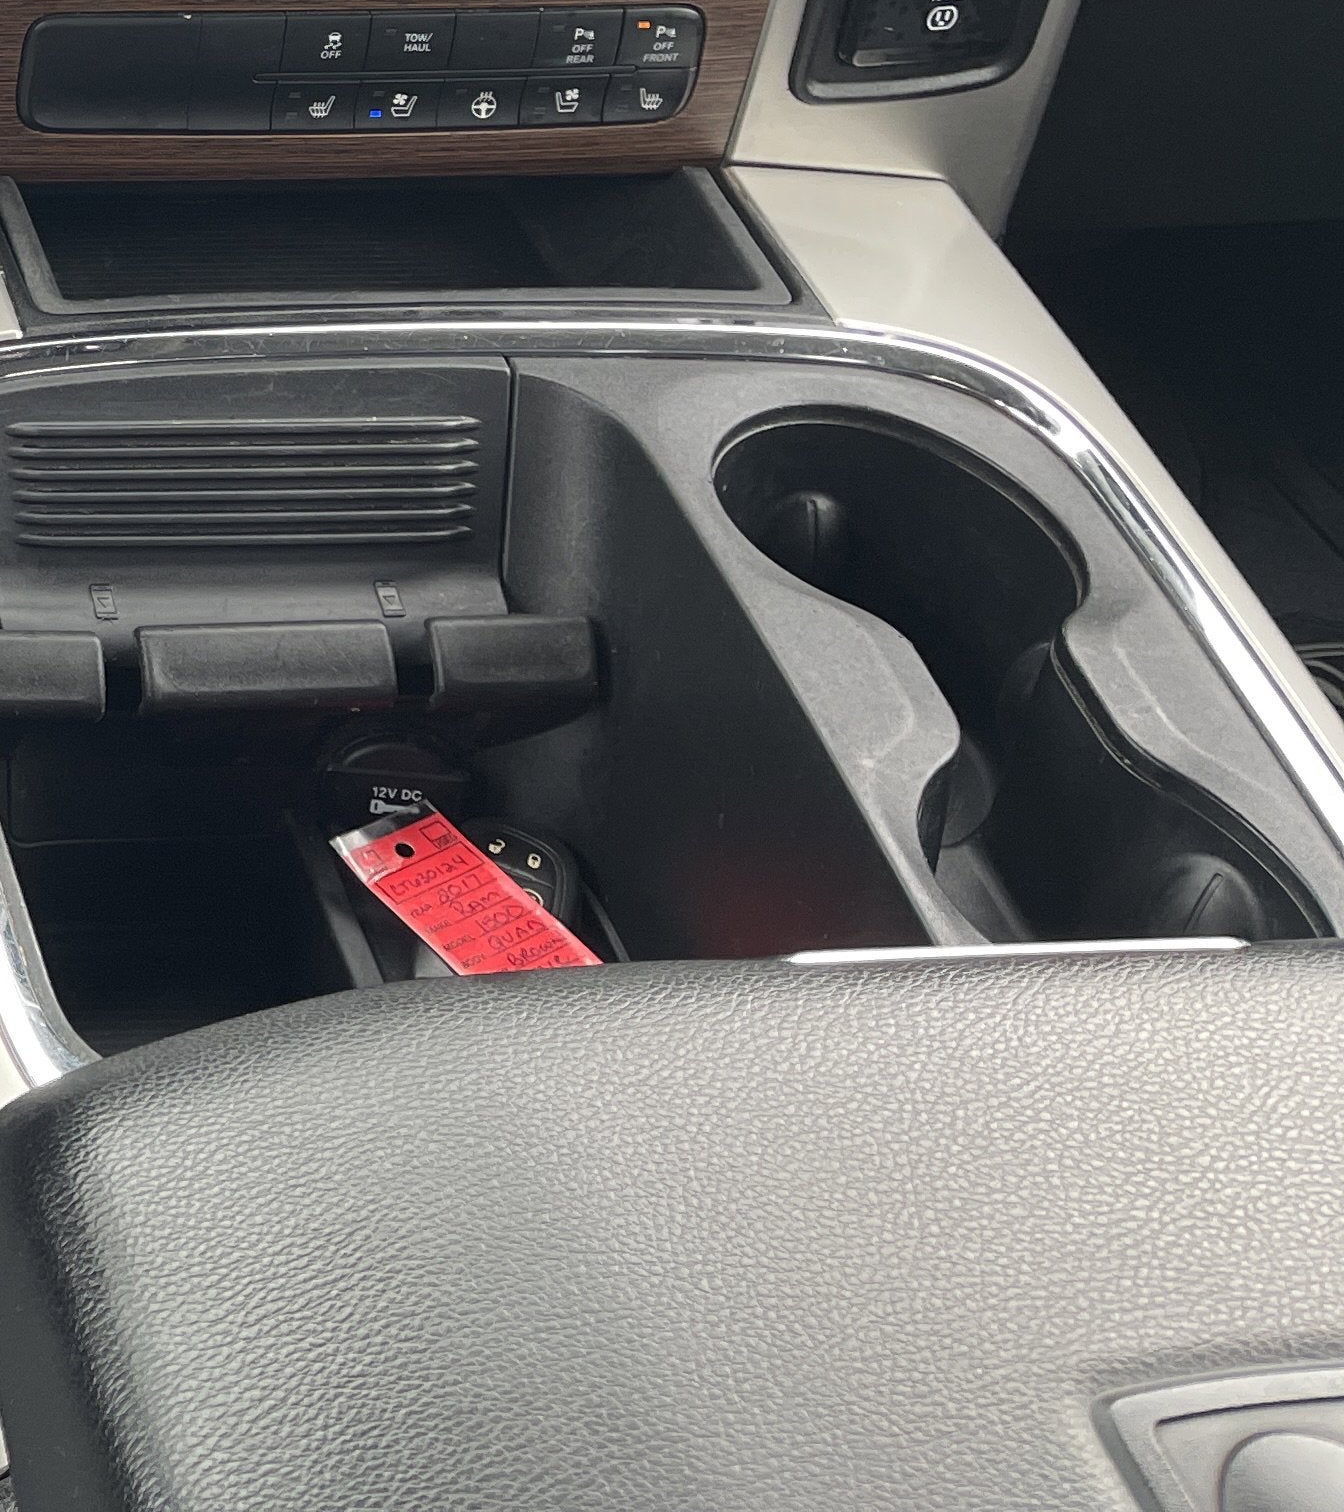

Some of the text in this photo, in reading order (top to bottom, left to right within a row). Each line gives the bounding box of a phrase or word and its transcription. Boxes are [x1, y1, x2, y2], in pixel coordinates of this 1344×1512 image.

[404, 32, 434, 43] TOW/
[403, 43, 432, 52] HAUL
[571, 43, 594, 54] OFF
[652, 41, 675, 51] OFF
[320, 49, 342, 60] OFF
[565, 54, 595, 64] REAR
[642, 52, 680, 63] FRONT
[373, 787, 422, 801] 12V DC
